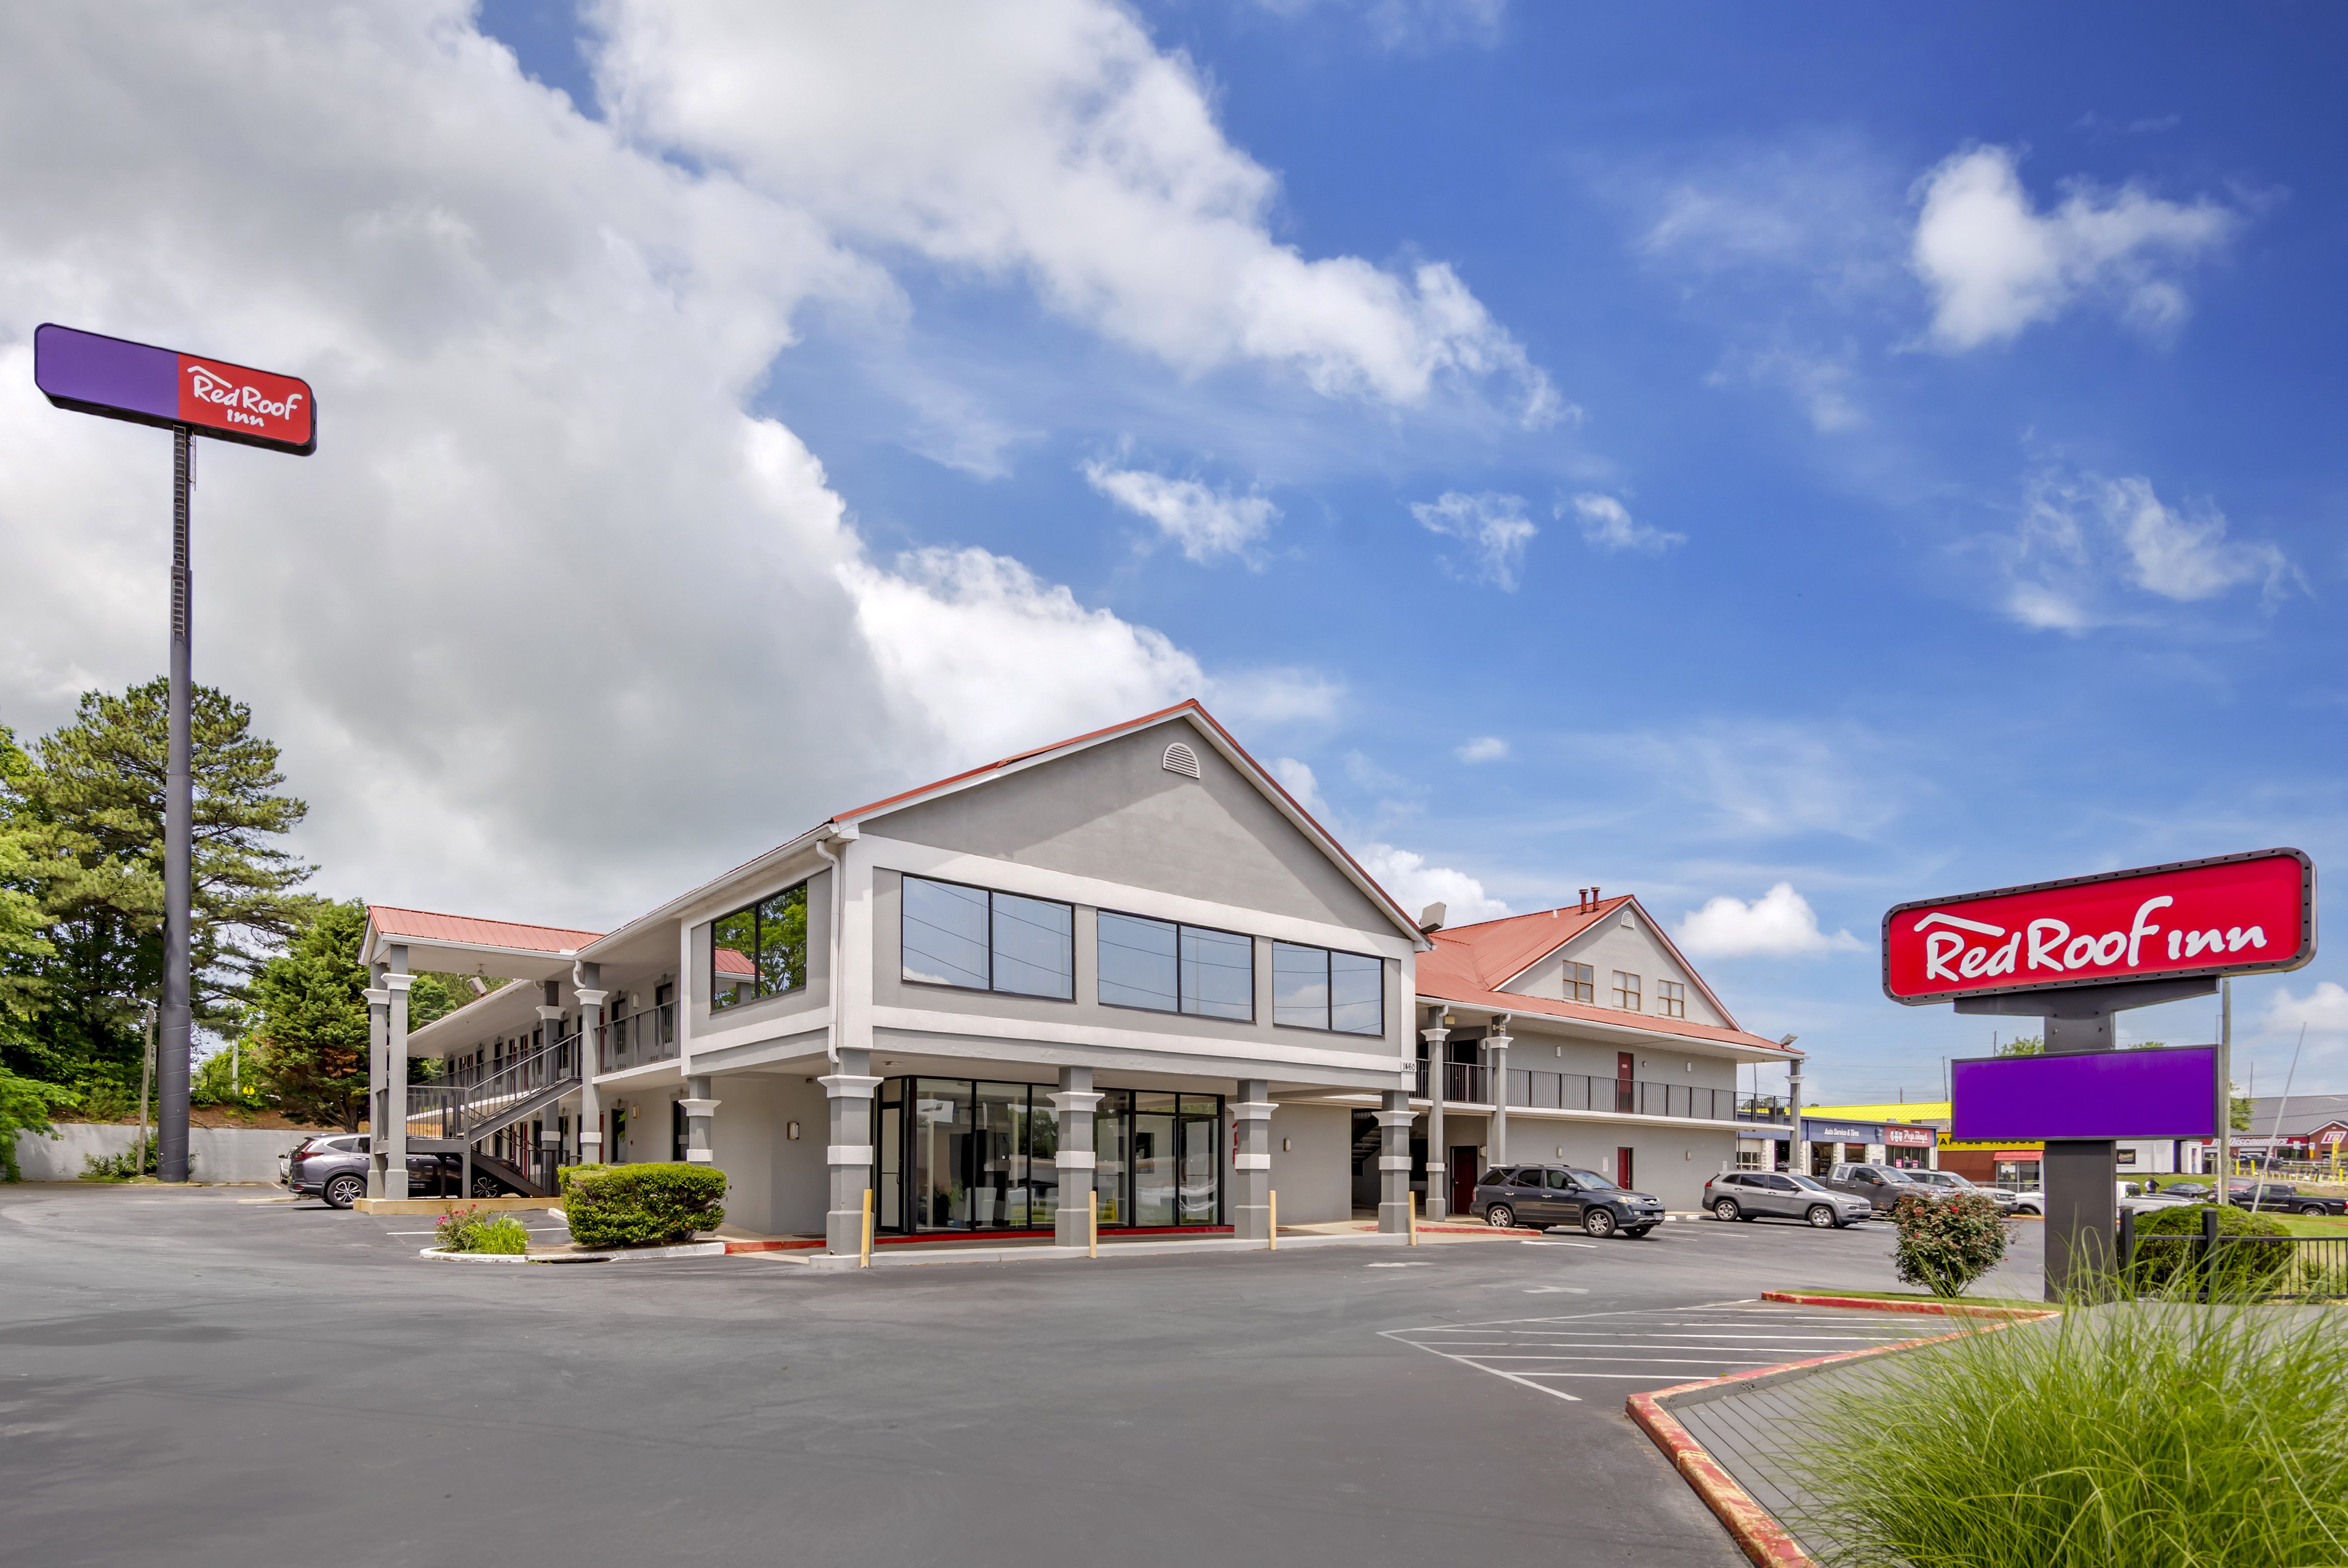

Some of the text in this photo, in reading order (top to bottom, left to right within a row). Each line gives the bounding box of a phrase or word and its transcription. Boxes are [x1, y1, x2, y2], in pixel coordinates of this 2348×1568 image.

[227, 409, 265, 427] inn
[2168, 925, 2267, 960] inn
[1403, 1062, 1415, 1071] 1460
[1904, 1130, 1915, 1142] Pep
[1915, 1131, 1927, 1144] Boys
